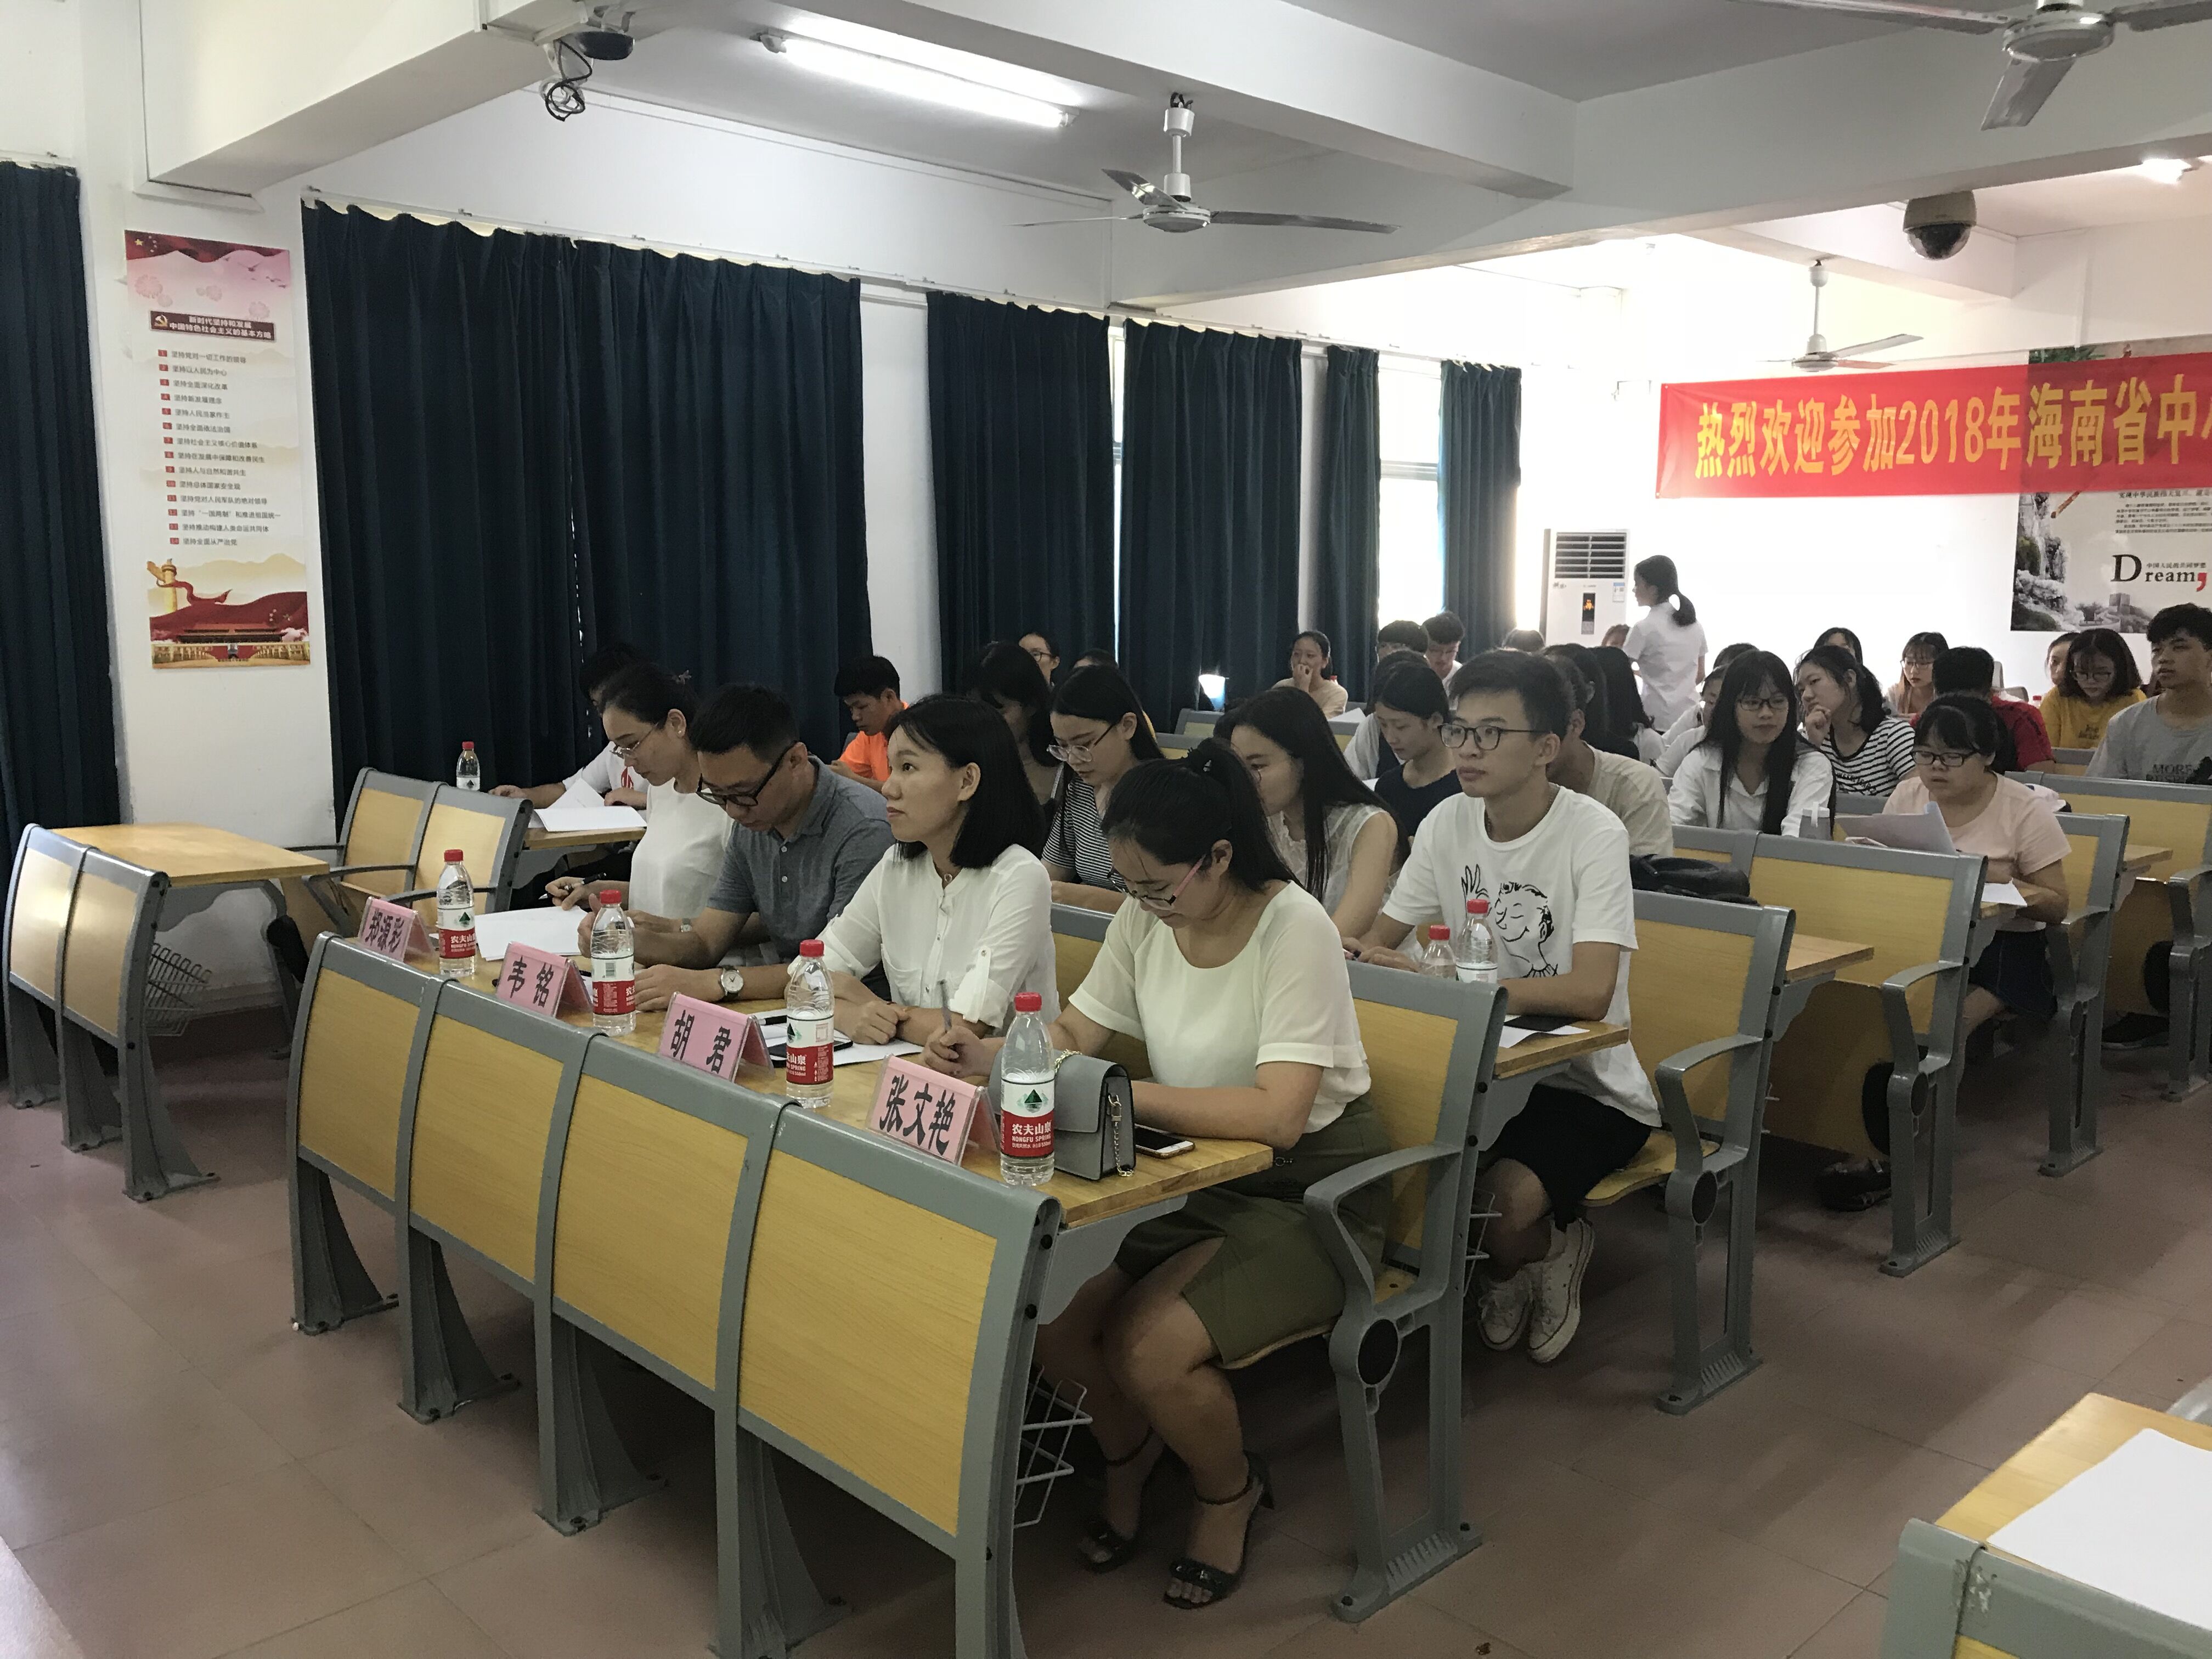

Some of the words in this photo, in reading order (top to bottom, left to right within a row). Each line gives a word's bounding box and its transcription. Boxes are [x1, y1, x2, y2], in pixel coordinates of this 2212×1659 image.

[189, 315, 251, 329] 新时代坚持和发展
[169, 323, 272, 339] 中国特色社会主义的基本方略
[1695, 374, 2212, 478] 热烈欢迎参加2018年海南省中
[879, 1074, 956, 1155] 张文艳
[1012, 1121, 1052, 1136] 农夫山泉
[1035, 1133, 1051, 1142] SPRING
